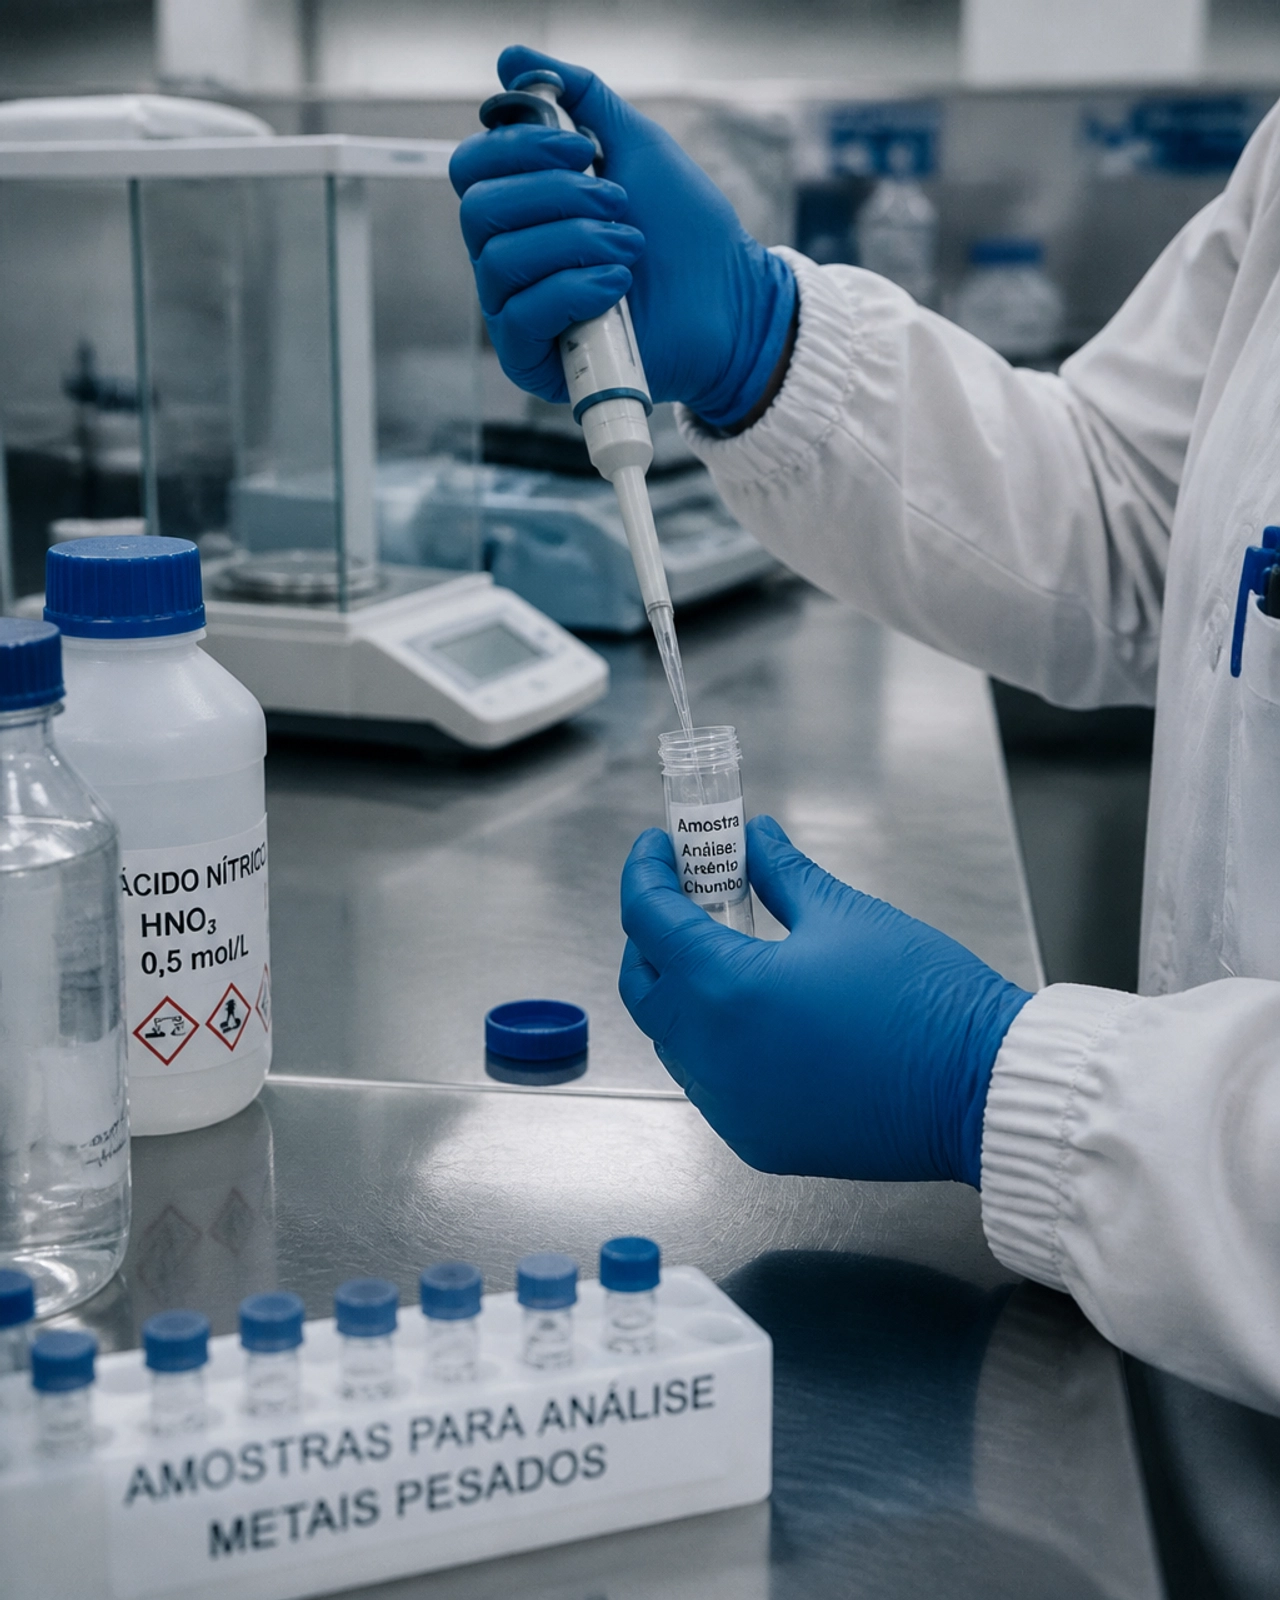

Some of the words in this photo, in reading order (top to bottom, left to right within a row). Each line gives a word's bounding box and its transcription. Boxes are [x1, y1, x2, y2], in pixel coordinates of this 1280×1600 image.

[678, 815, 739, 832] Amostra
[120, 867, 199, 896] ÁCIDO
[684, 878, 743, 894] Chumbo
[141, 949, 182, 978] 0,5
[191, 934, 249, 970] mol/L
[123, 1422, 391, 1506] AMOSTRAS
[409, 1404, 524, 1454] PARA
[537, 1374, 715, 1436] ANÁLISE
[209, 1488, 381, 1558] METAIS
[396, 1443, 608, 1517] PESADOS
